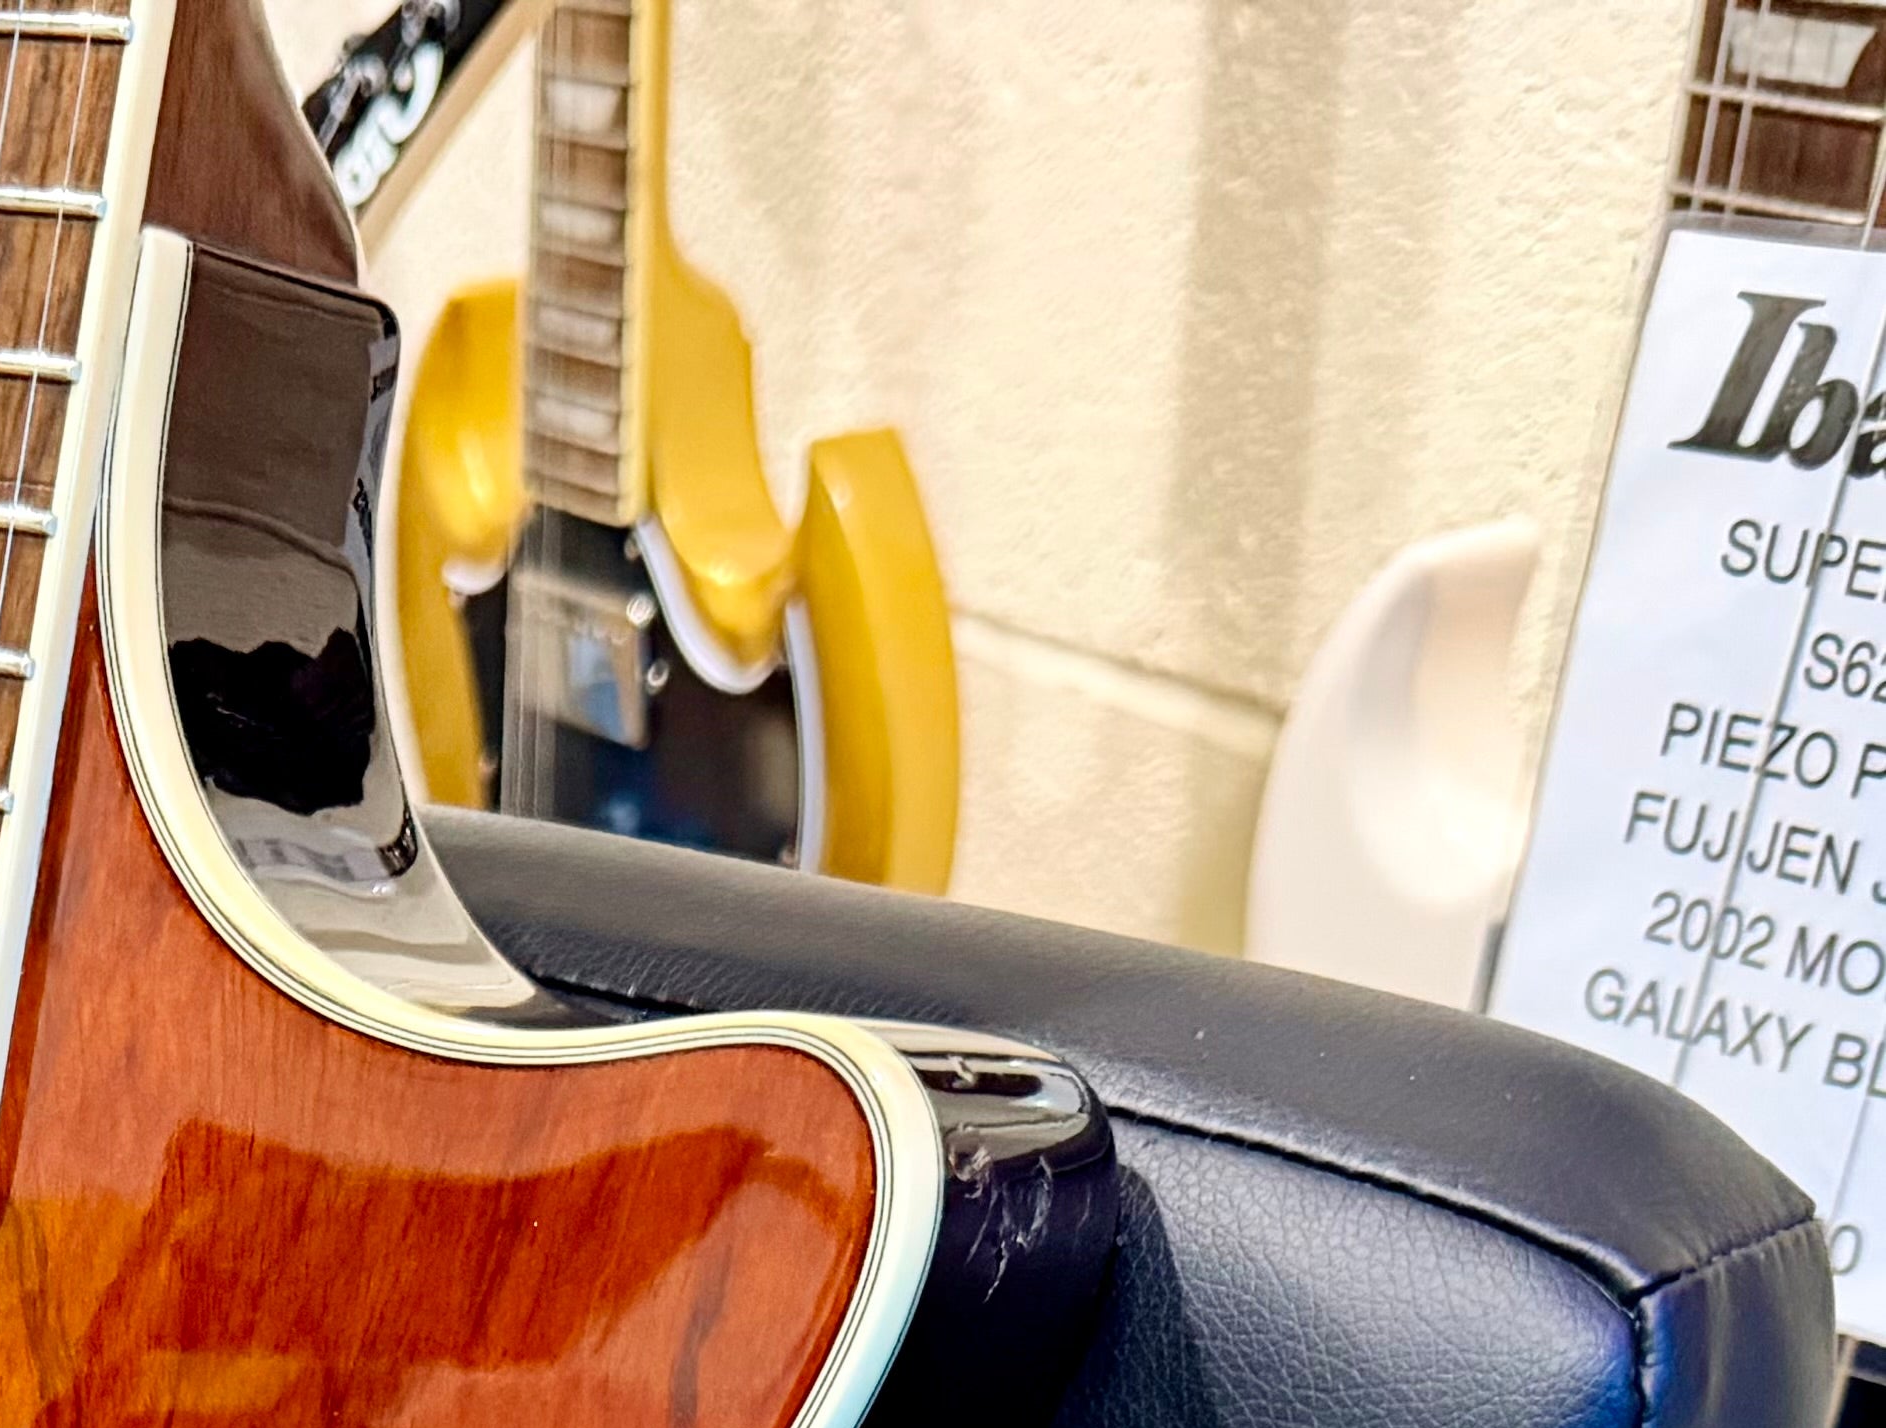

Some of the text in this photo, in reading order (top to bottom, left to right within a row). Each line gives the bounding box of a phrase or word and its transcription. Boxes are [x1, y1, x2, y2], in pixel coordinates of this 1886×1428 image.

[1720, 518, 1886, 603] SUPE
[1660, 702, 1838, 789] PIEZO
[1644, 890, 1886, 1003] 2002 MO
[1584, 967, 1814, 1072] GALAXY
